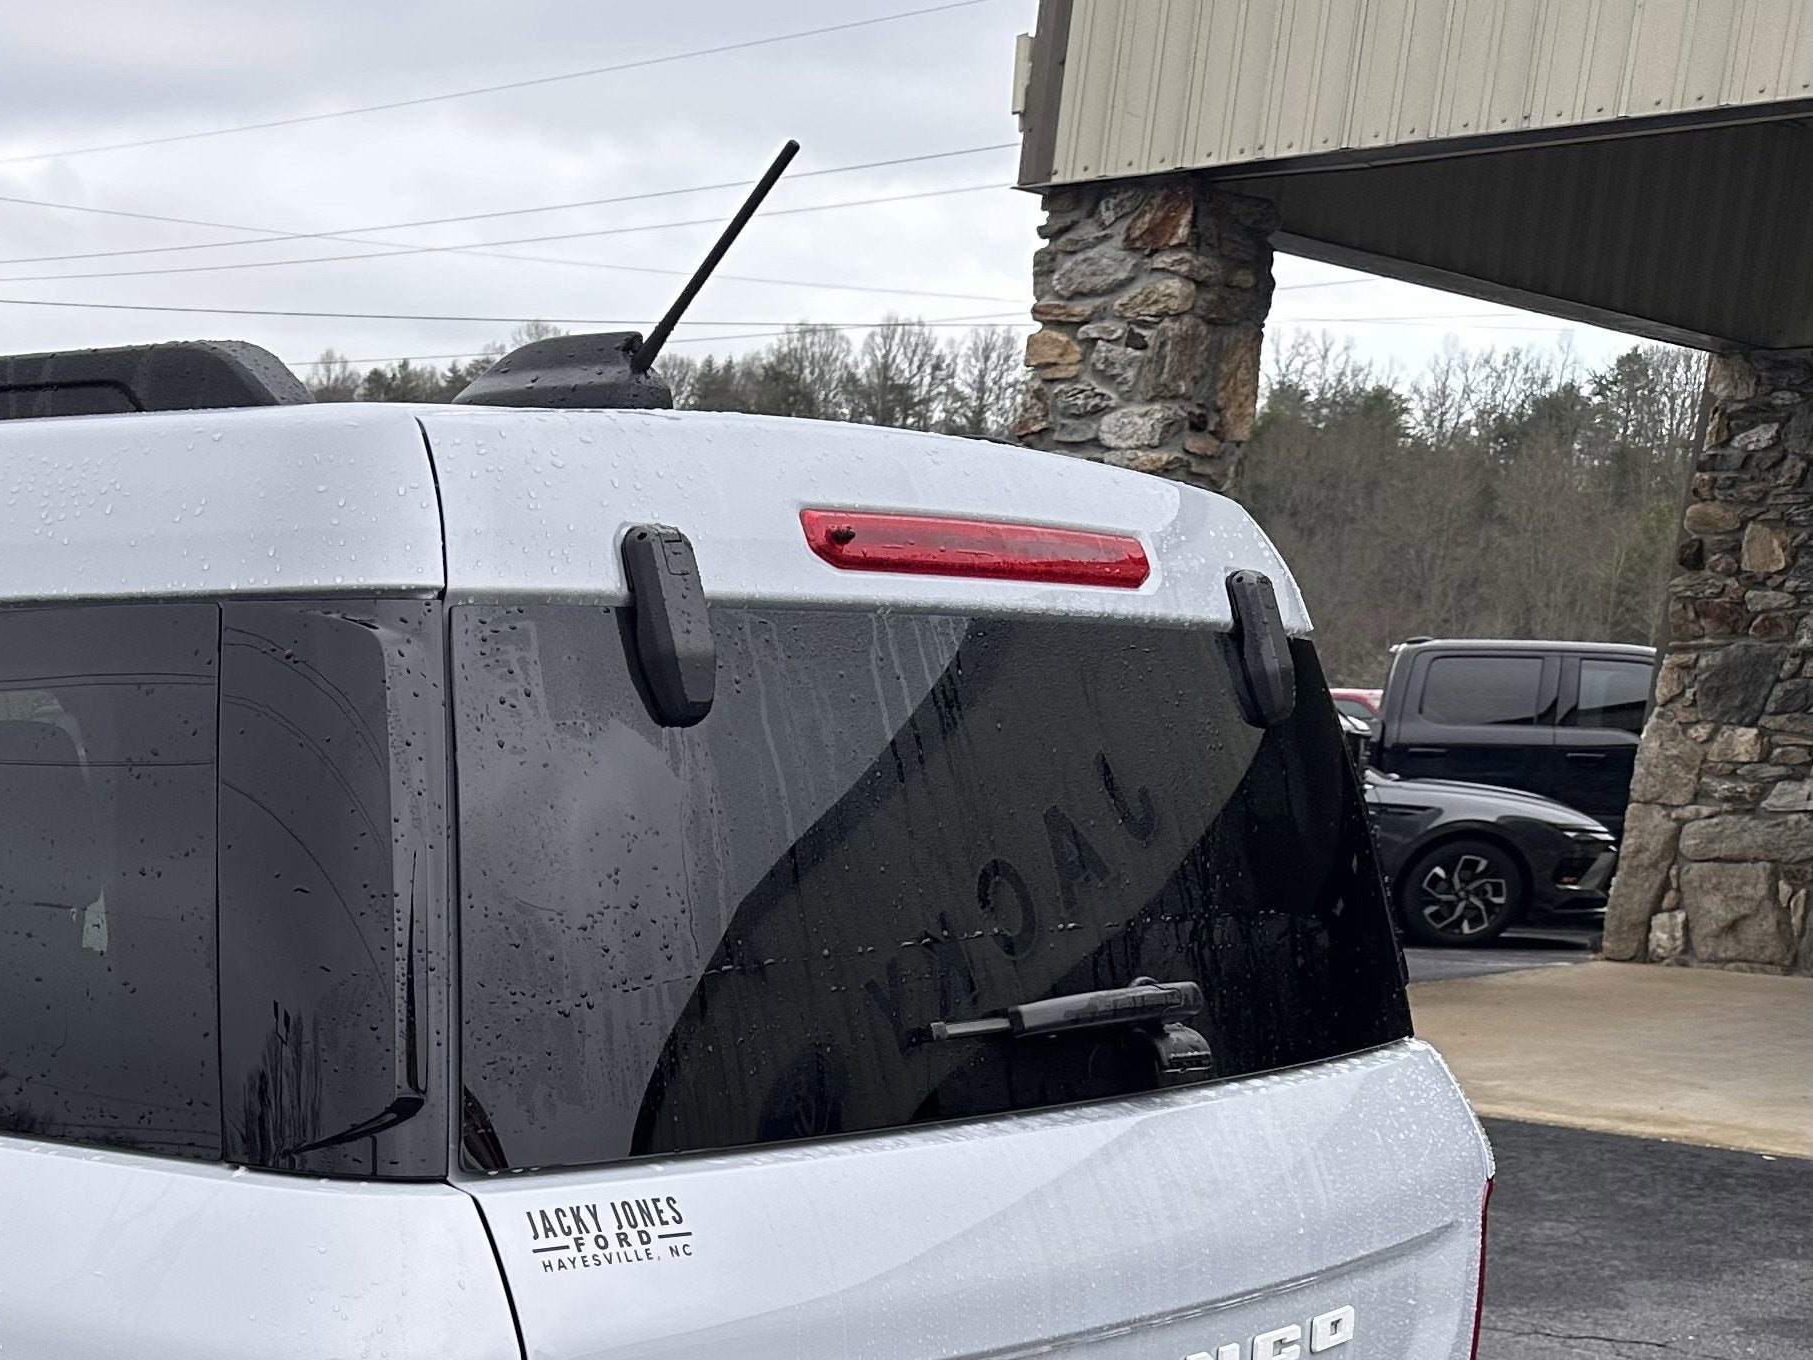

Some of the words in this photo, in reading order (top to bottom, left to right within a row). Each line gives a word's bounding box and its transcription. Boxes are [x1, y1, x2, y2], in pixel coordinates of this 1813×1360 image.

[526, 1203, 602, 1241] JACKY
[610, 1196, 684, 1230] JONES
[573, 1229, 653, 1253] FORD
[542, 1248, 661, 1272] HAYESVILLE,
[669, 1243, 694, 1258] NC
